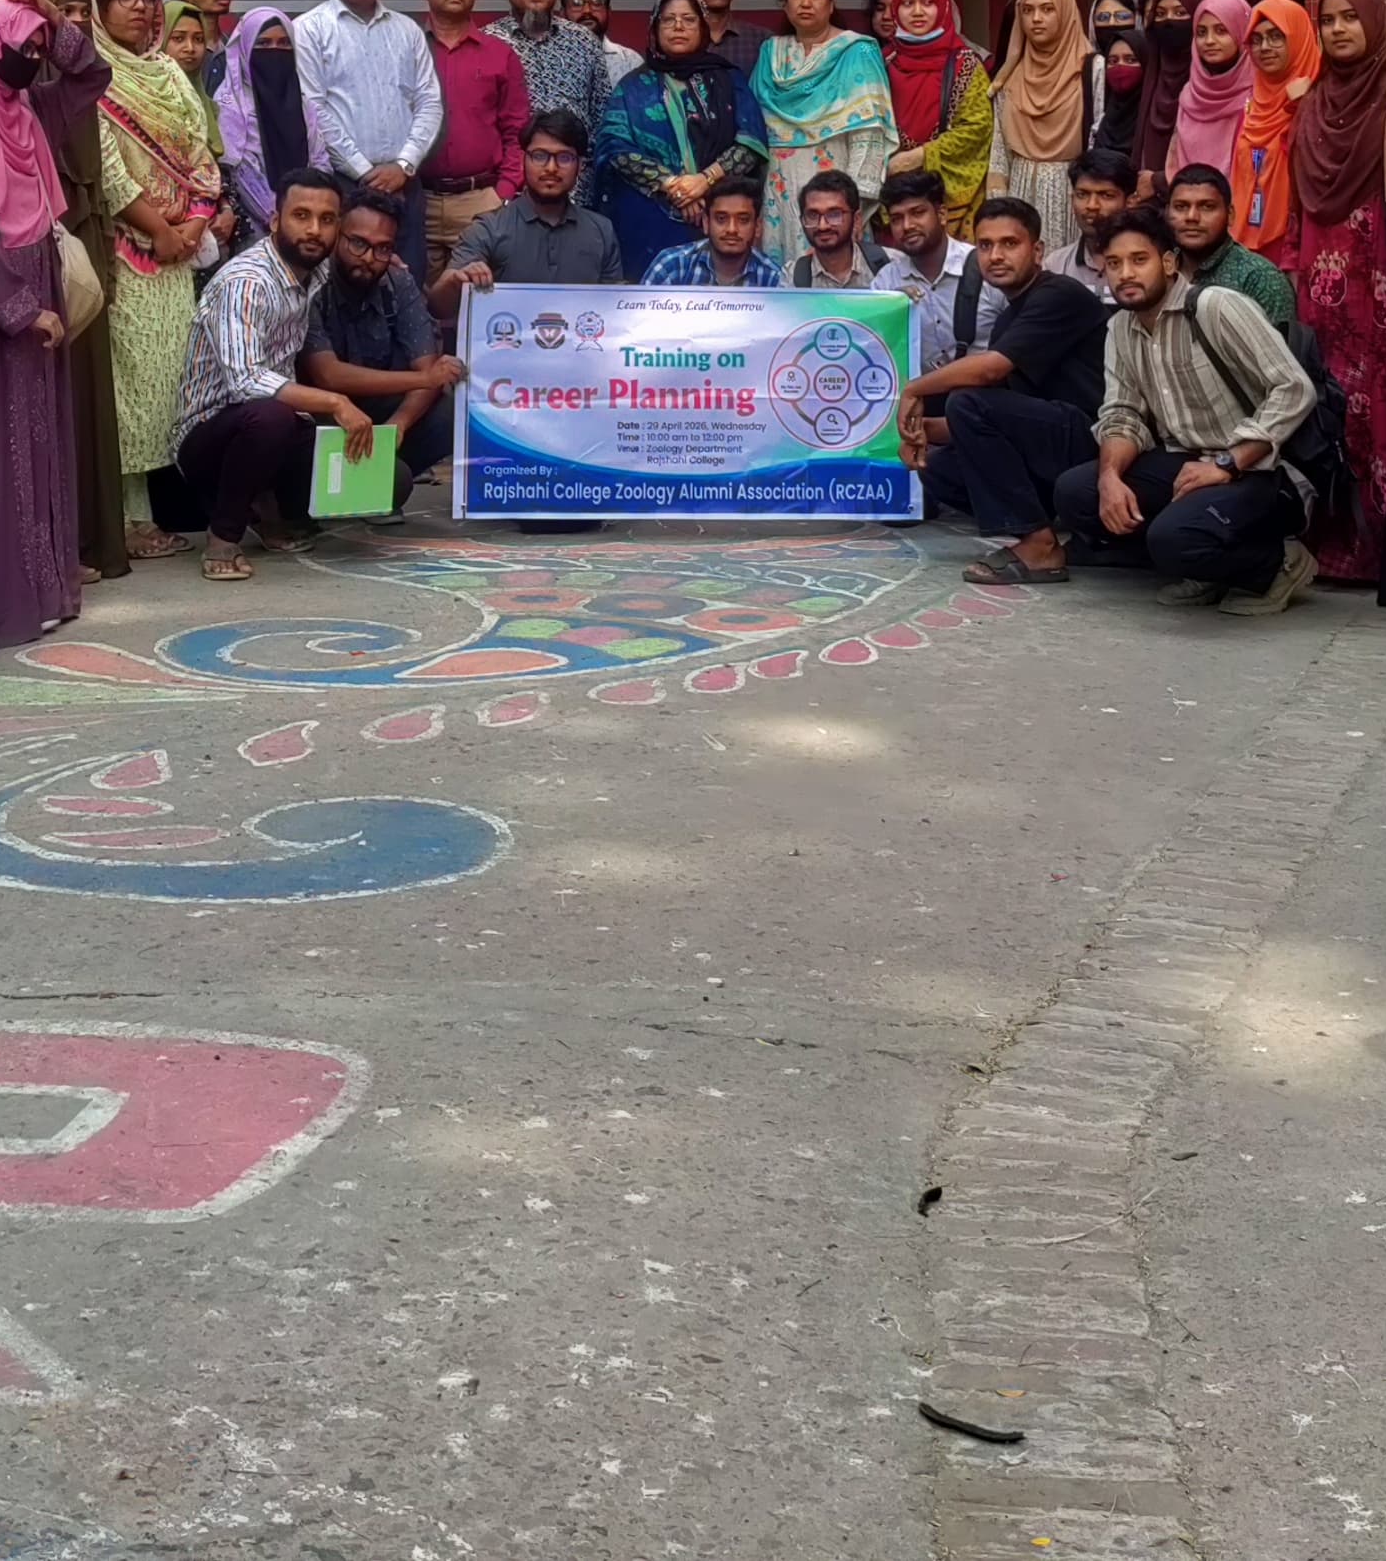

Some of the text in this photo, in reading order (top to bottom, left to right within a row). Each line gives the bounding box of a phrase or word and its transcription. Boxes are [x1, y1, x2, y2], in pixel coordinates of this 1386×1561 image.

[616, 298, 765, 314] Learn Today, Lead Tomorrow
[619, 346, 745, 372] Training on
[818, 376, 846, 384] CAREER
[487, 377, 757, 417] Career Planning
[616, 421, 640, 431] Date
[661, 421, 682, 432] April
[711, 421, 767, 433] Wednesday
[616, 433, 640, 442] Time
[690, 433, 700, 442] to
[726, 435, 744, 444] pm
[646, 445, 683, 455] Zoology
[685, 444, 743, 455] Department
[689, 456, 725, 466] College
[483, 465, 537, 478] Organized
[539, 465, 553, 477] By
[484, 477, 893, 505] Rajshahi College Zoology Alumni Association (RCZAA)
